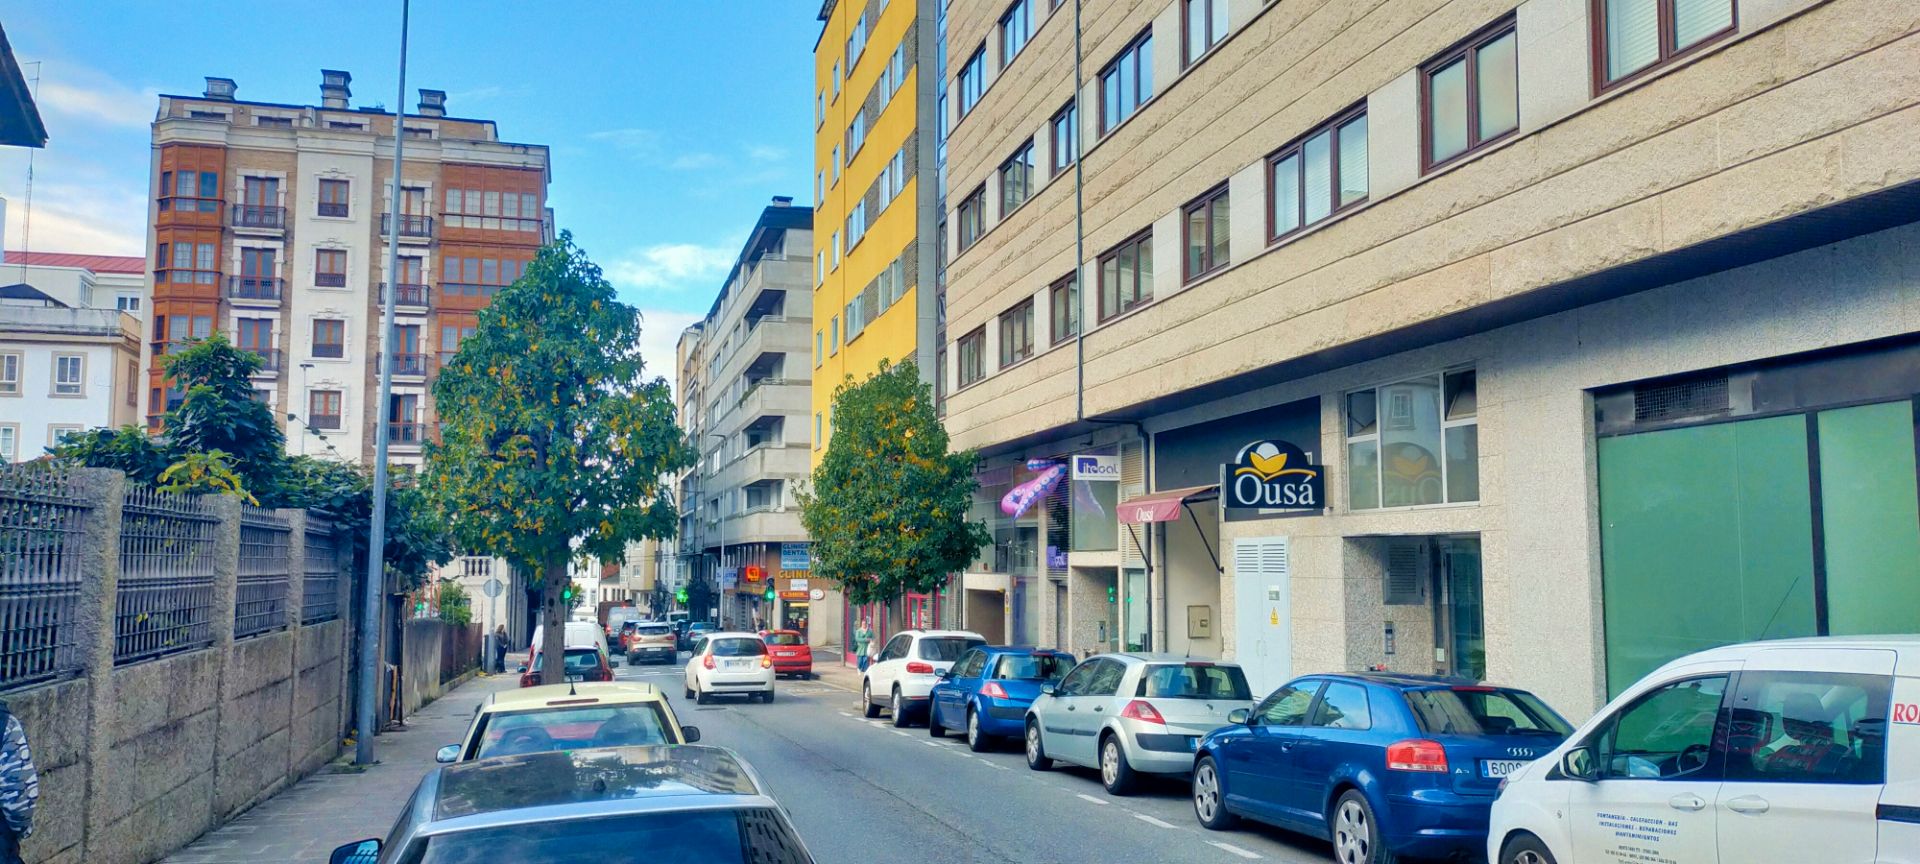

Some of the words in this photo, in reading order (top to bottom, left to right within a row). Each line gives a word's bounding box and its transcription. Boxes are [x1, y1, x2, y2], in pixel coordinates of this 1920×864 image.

[1235, 474, 1315, 505] Ousá
[1136, 506, 1153, 521] Ousá
[779, 570, 816, 579] CLINIC
[1893, 703, 1920, 723] RO
[1640, 826, 1677, 836] REPARACIONES
